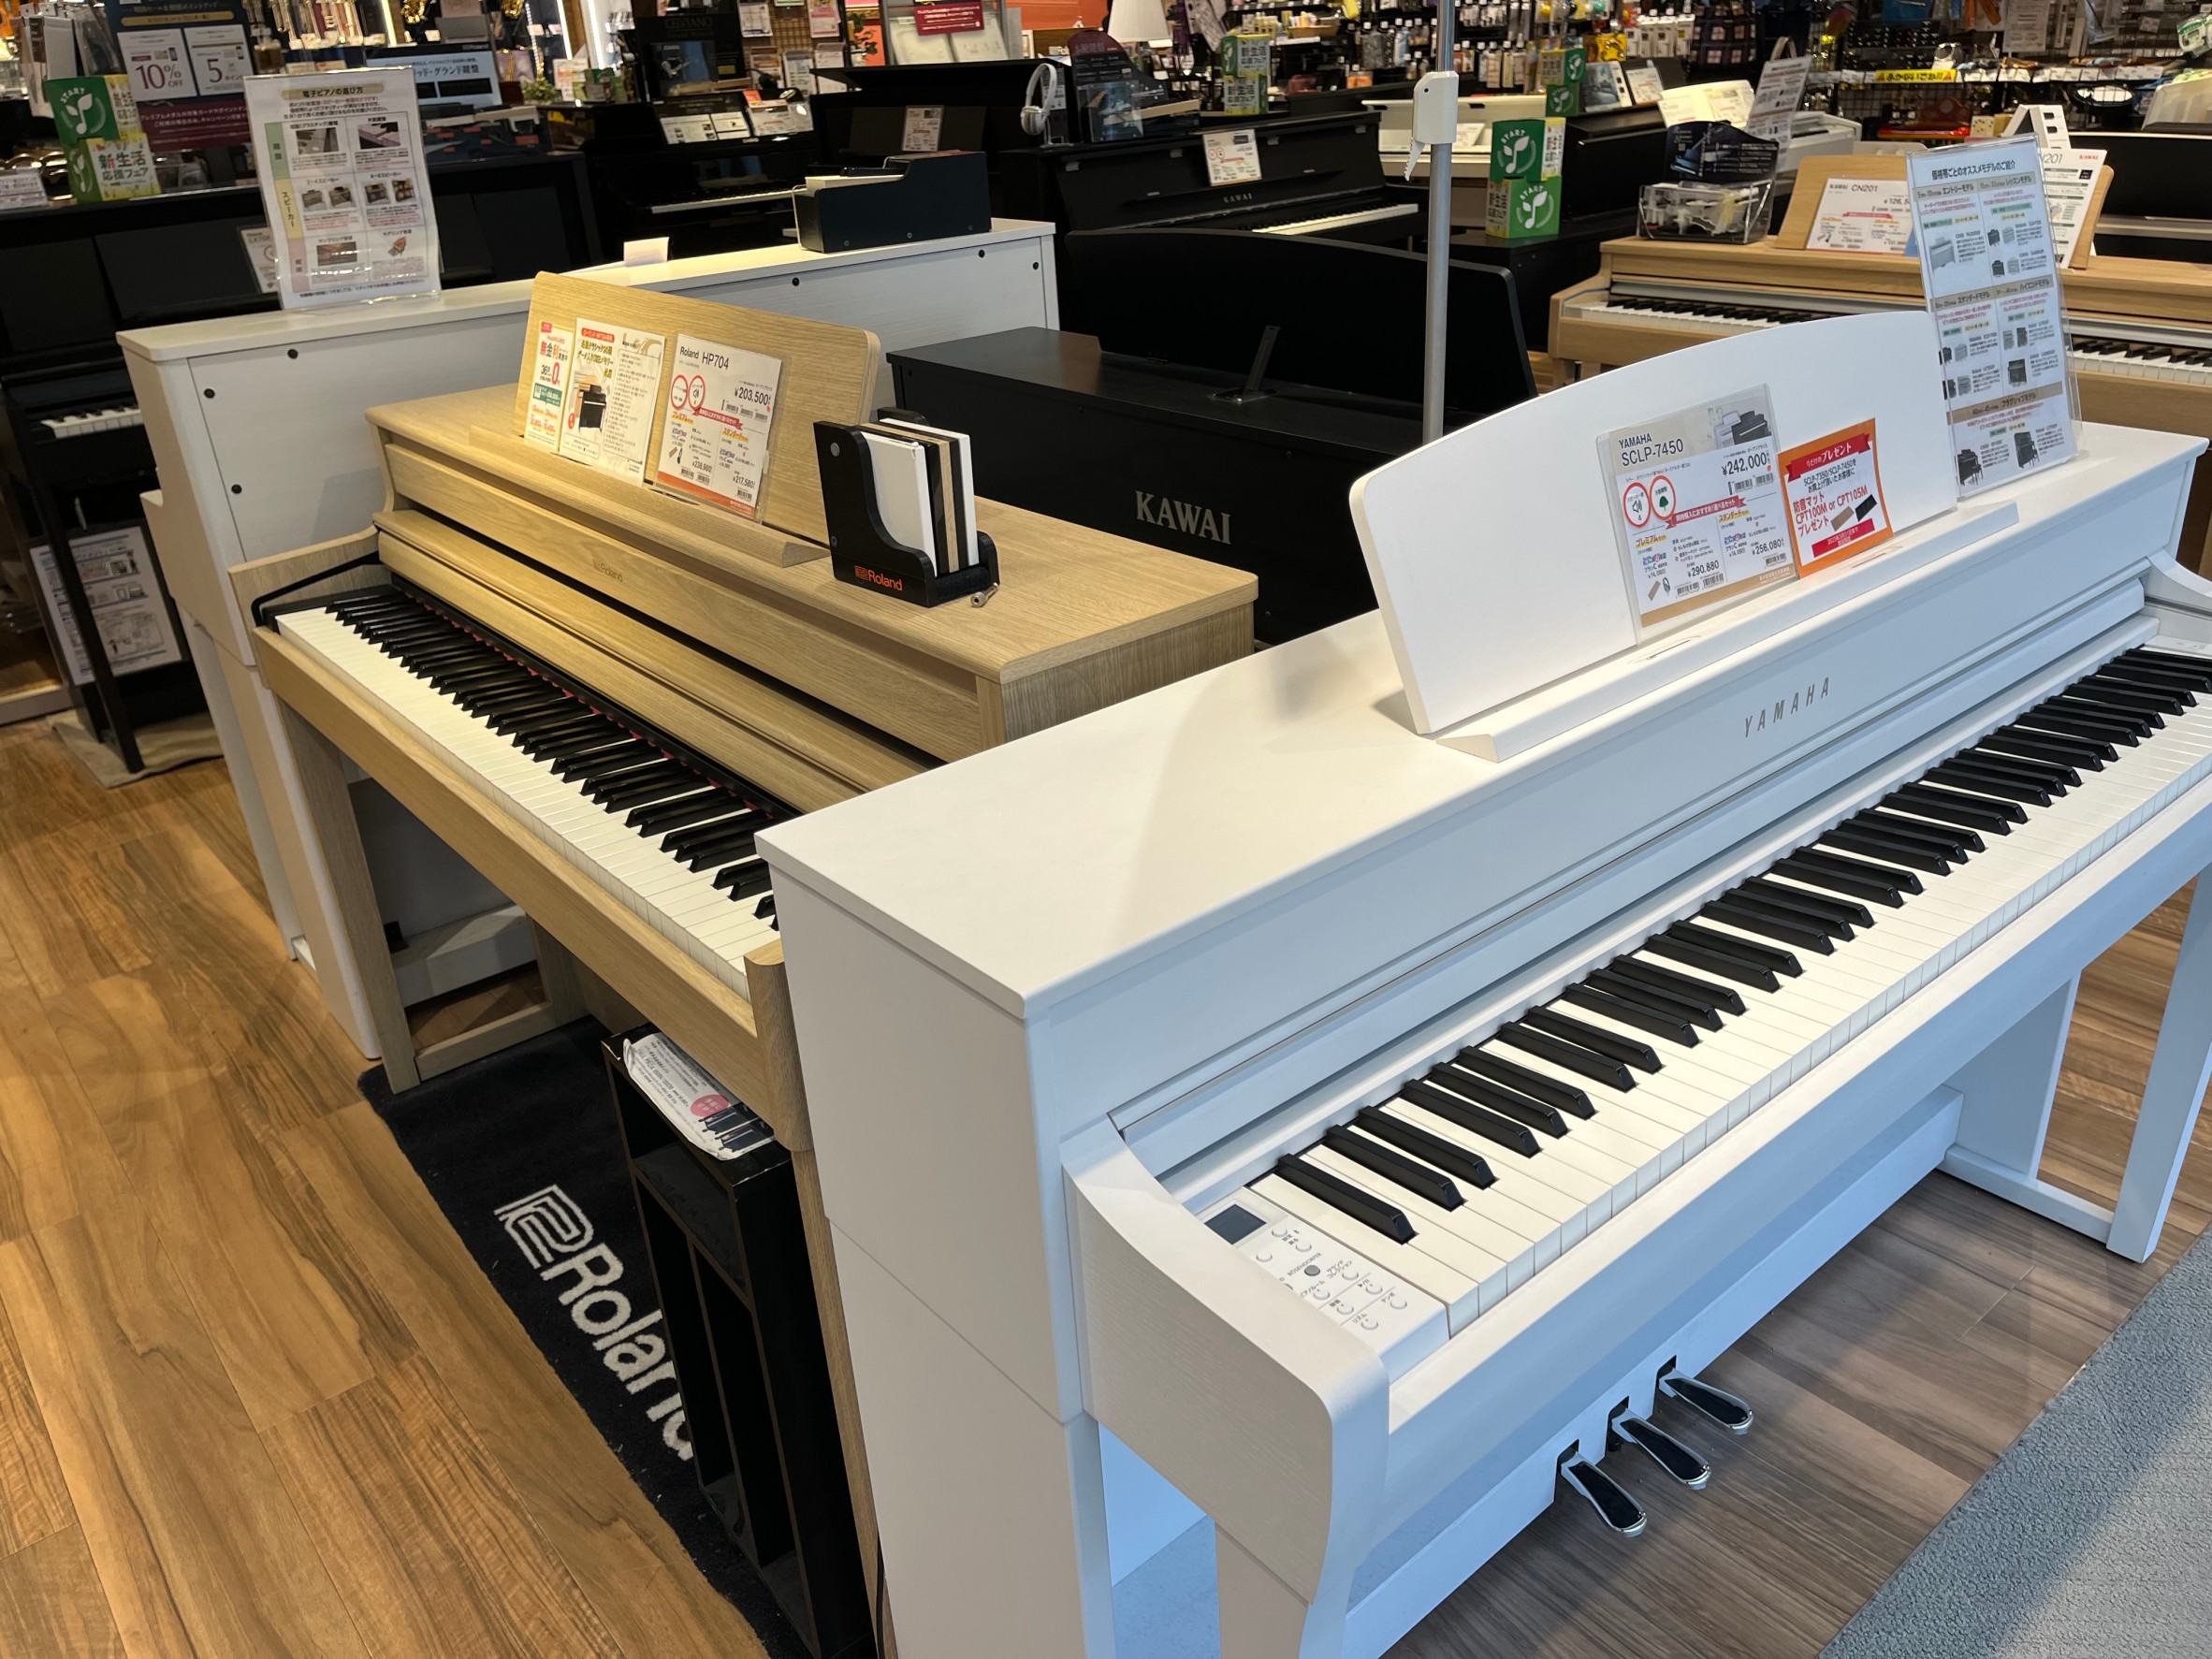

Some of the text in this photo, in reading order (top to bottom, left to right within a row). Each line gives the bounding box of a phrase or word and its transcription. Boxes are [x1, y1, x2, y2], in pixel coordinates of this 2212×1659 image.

[135, 64, 182, 90] 10%
[60, 88, 85, 104] START
[302, 86, 363, 98] 電子ピアノの選び方
[1501, 129, 1526, 144] START
[98, 151, 146, 169] 新生活
[102, 167, 148, 182] 応援フェア
[1520, 185, 1544, 200] START
[1852, 183, 1878, 192] CN201
[680, 346, 729, 370] Roland HP704
[735, 386, 768, 406] ¥203,500
[1619, 432, 1652, 449] YAMAHA
[1622, 438, 1683, 467] SCLP-7450
[1722, 452, 1767, 477] ¥242,000
[1793, 491, 1825, 514] 防音マット
[1796, 485, 1869, 524] CPT100M or CPT105M
[1135, 490, 1231, 545] KAWAI
[1797, 517, 1829, 538] プレゼント
[868, 569, 903, 591] Roland
[1745, 677, 1828, 737] YAMAHA
